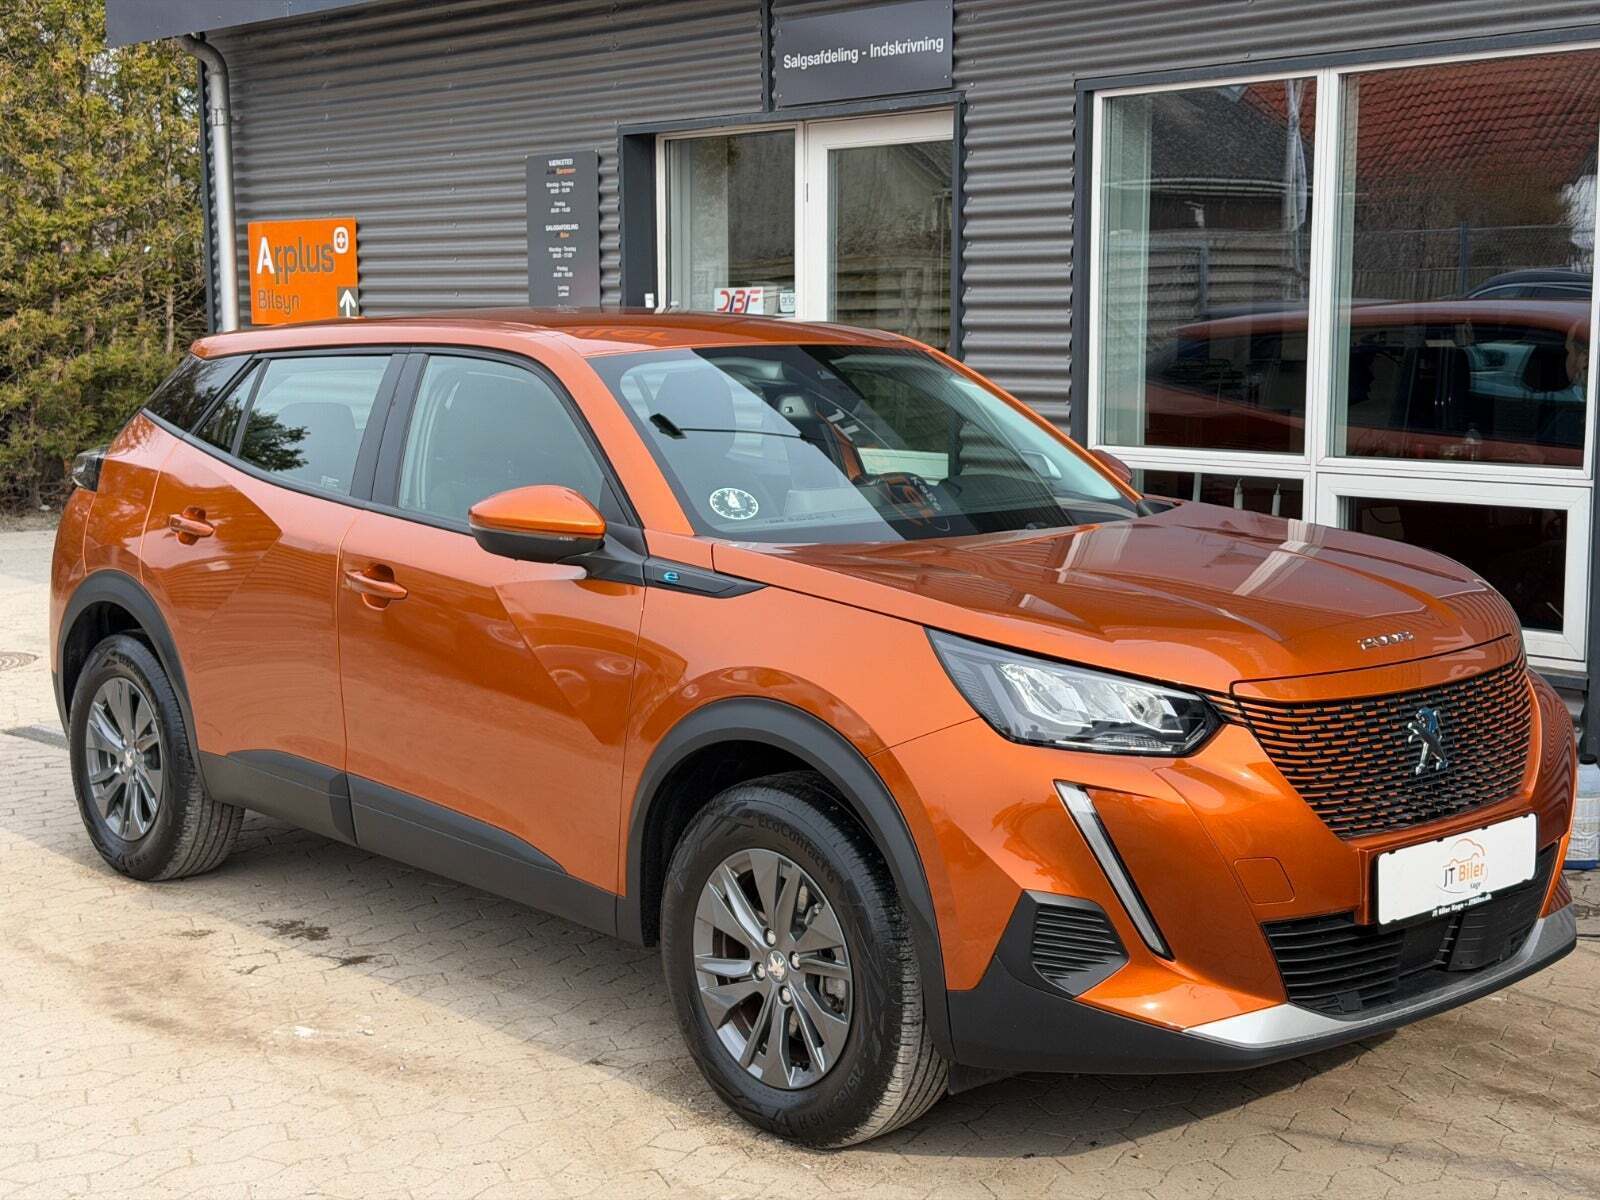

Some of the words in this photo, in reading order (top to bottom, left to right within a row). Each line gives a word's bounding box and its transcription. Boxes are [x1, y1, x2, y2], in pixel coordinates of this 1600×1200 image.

[783, 47, 859, 70] Salgsafdeling
[870, 36, 944, 58] Indskrivning
[258, 289, 300, 315] Bilsyn
[1444, 867, 1456, 888] JT
[1458, 862, 1484, 882] Biler
